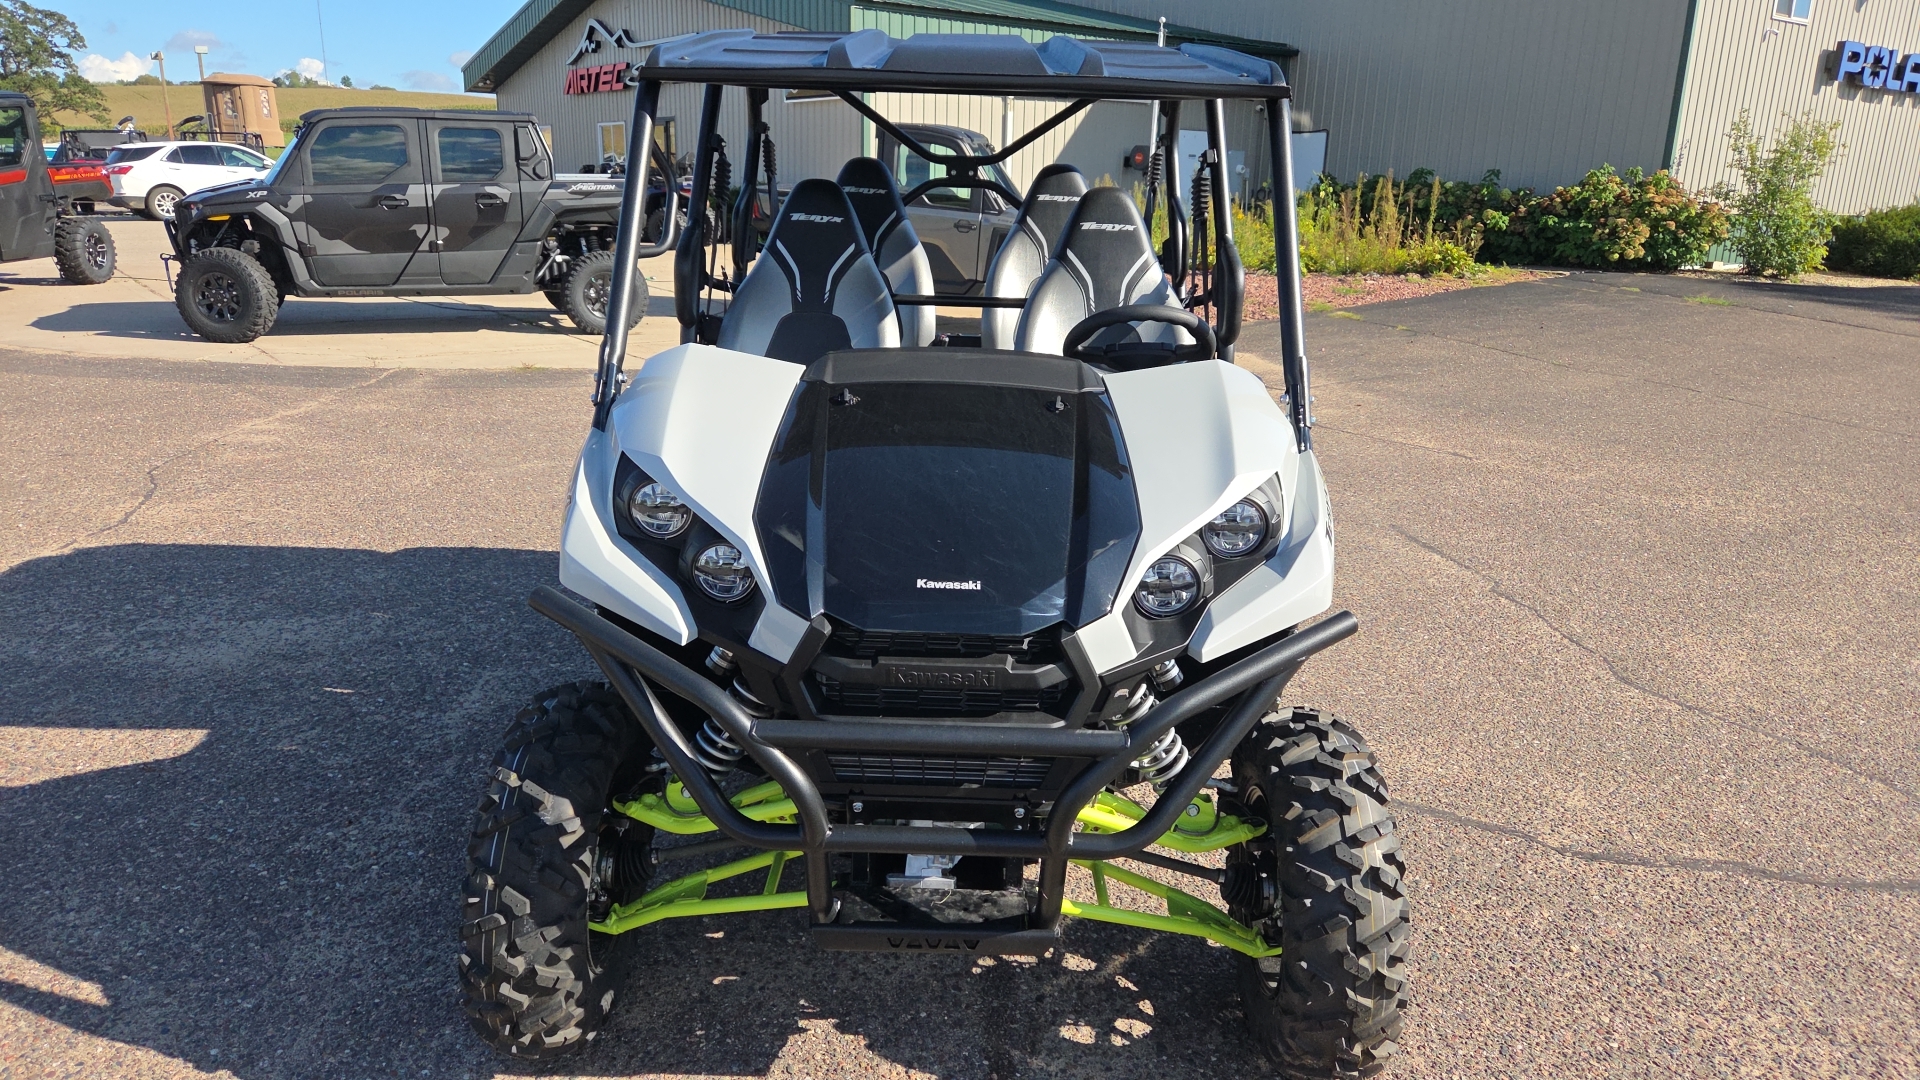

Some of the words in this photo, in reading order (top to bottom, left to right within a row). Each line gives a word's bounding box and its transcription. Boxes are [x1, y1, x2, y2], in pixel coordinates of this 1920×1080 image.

[564, 62, 627, 95] AIRTEC
[567, 184, 615, 192] XPEDITION
[916, 579, 982, 590] Kawasaki
[886, 667, 996, 686] Kawasaki
